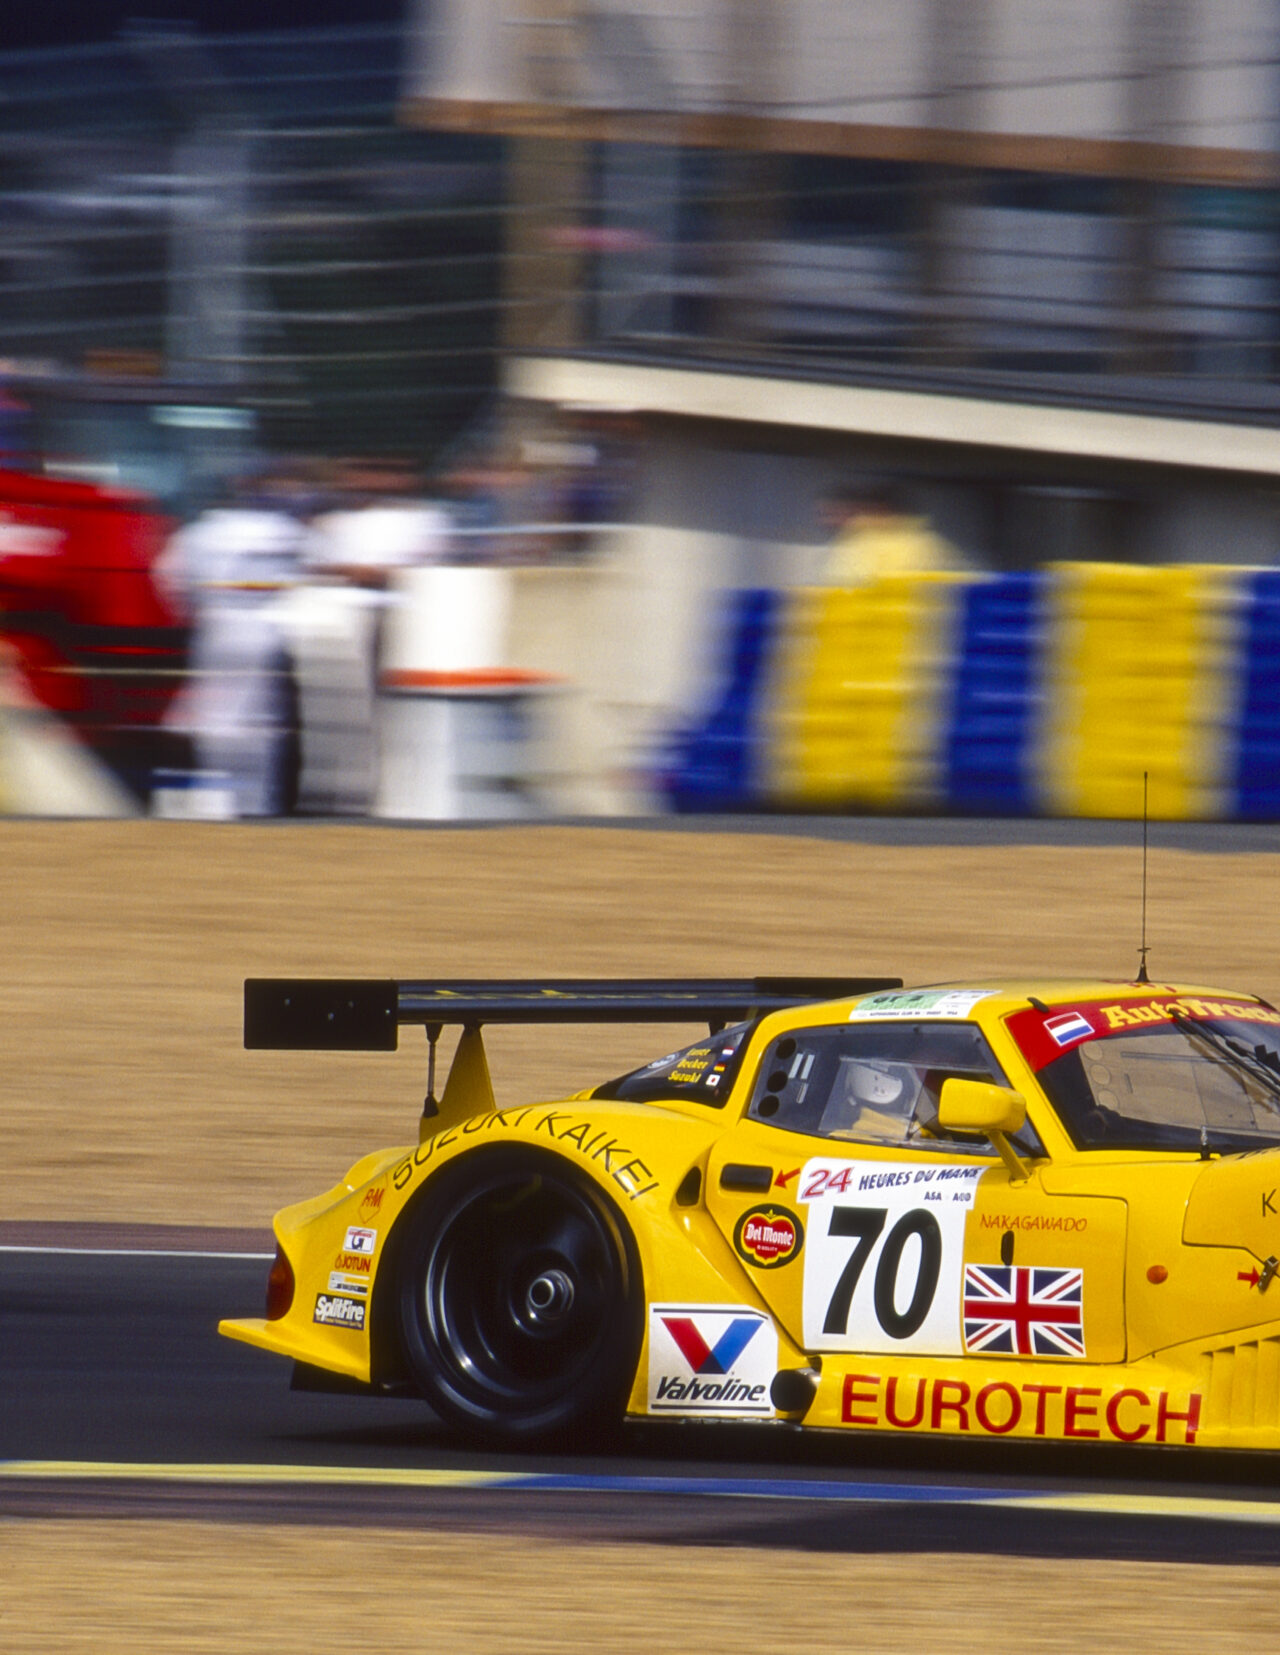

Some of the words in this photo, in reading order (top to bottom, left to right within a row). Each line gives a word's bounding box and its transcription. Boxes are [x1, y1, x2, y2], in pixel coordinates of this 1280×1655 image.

[667, 1070, 702, 1083] Suzuki
[535, 1111, 660, 1201] KAIKEI
[800, 1166, 855, 1200] 24
[858, 1170, 911, 1191] HEURES
[913, 1168, 935, 1183] DU
[936, 1166, 982, 1180] MANS
[923, 1191, 942, 1201] ASA
[745, 1223, 762, 1241] Del
[763, 1225, 793, 1246] Monte
[981, 1214, 1088, 1232] NAKAGAWADO
[341, 1256, 371, 1273] JOTUN
[822, 1205, 942, 1340] 70
[315, 1295, 365, 1322] SplitFire
[656, 1376, 766, 1401] Valvoline
[841, 1373, 1202, 1444] EUROTECH
